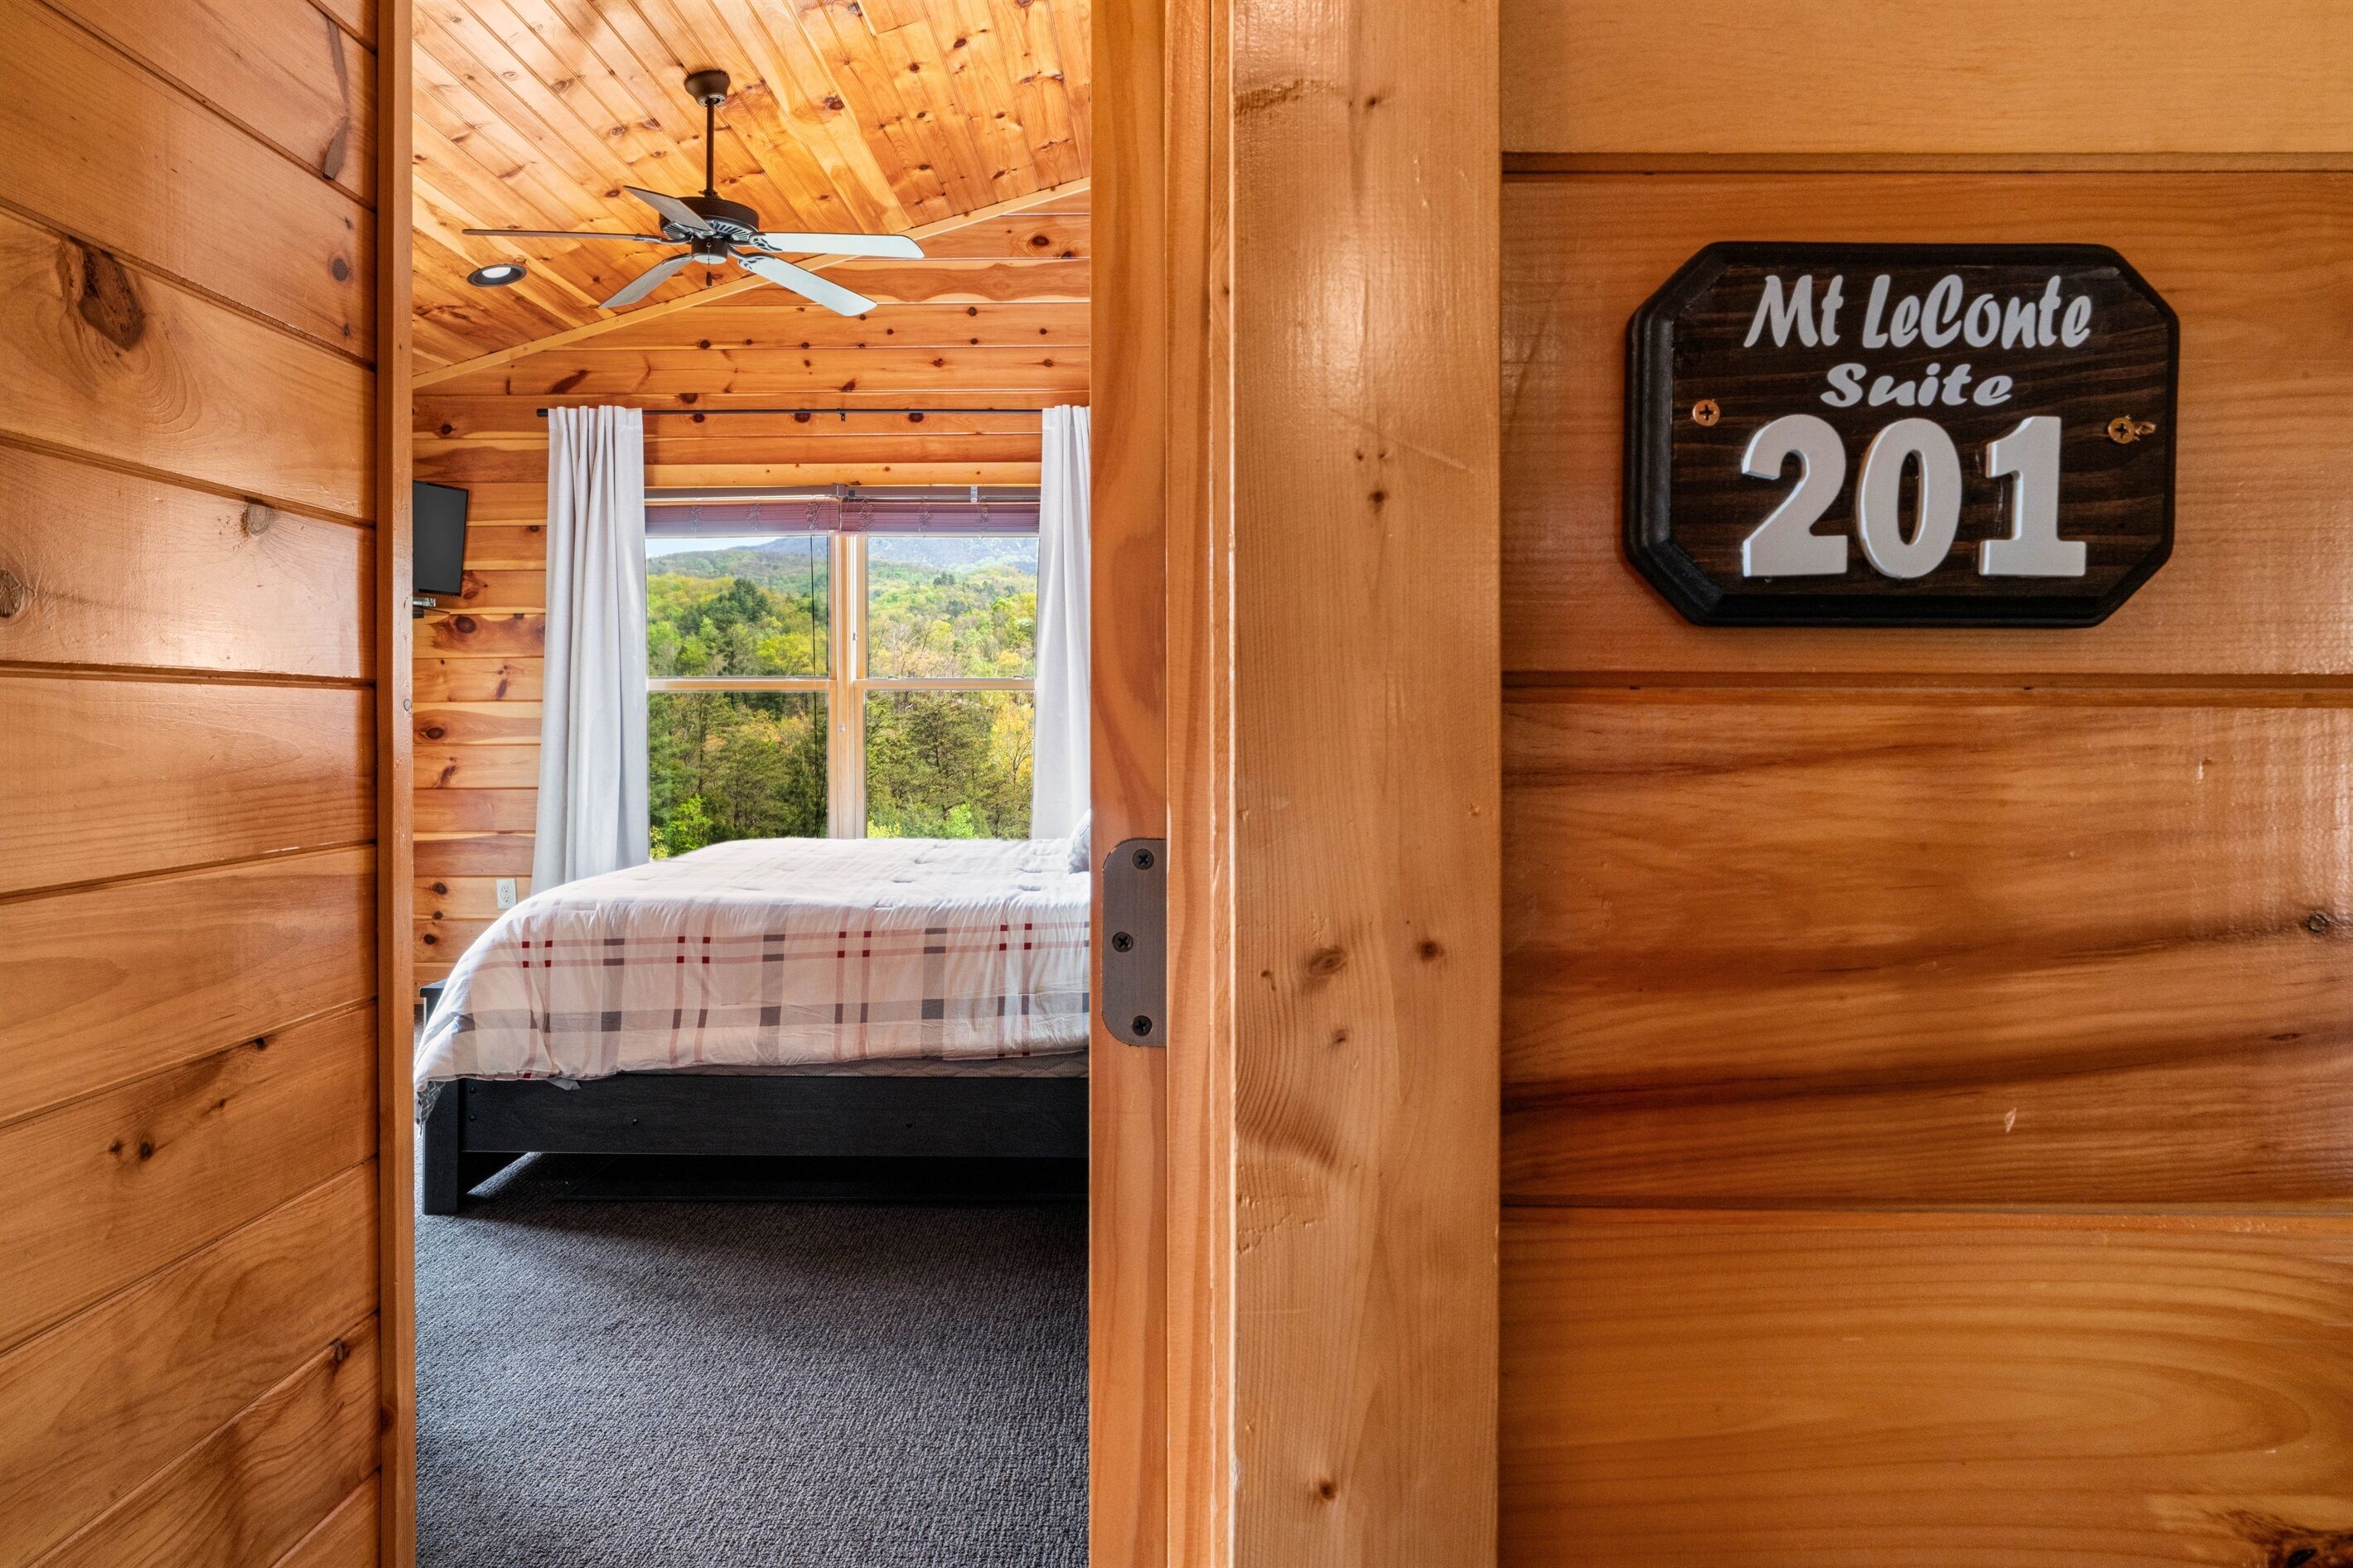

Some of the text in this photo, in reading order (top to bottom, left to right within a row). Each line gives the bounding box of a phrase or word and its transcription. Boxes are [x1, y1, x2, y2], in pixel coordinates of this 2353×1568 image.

[1743, 274, 2092, 350] Mt LeConte
[1820, 363, 2012, 407] Suite
[1740, 413, 2087, 579] 201
